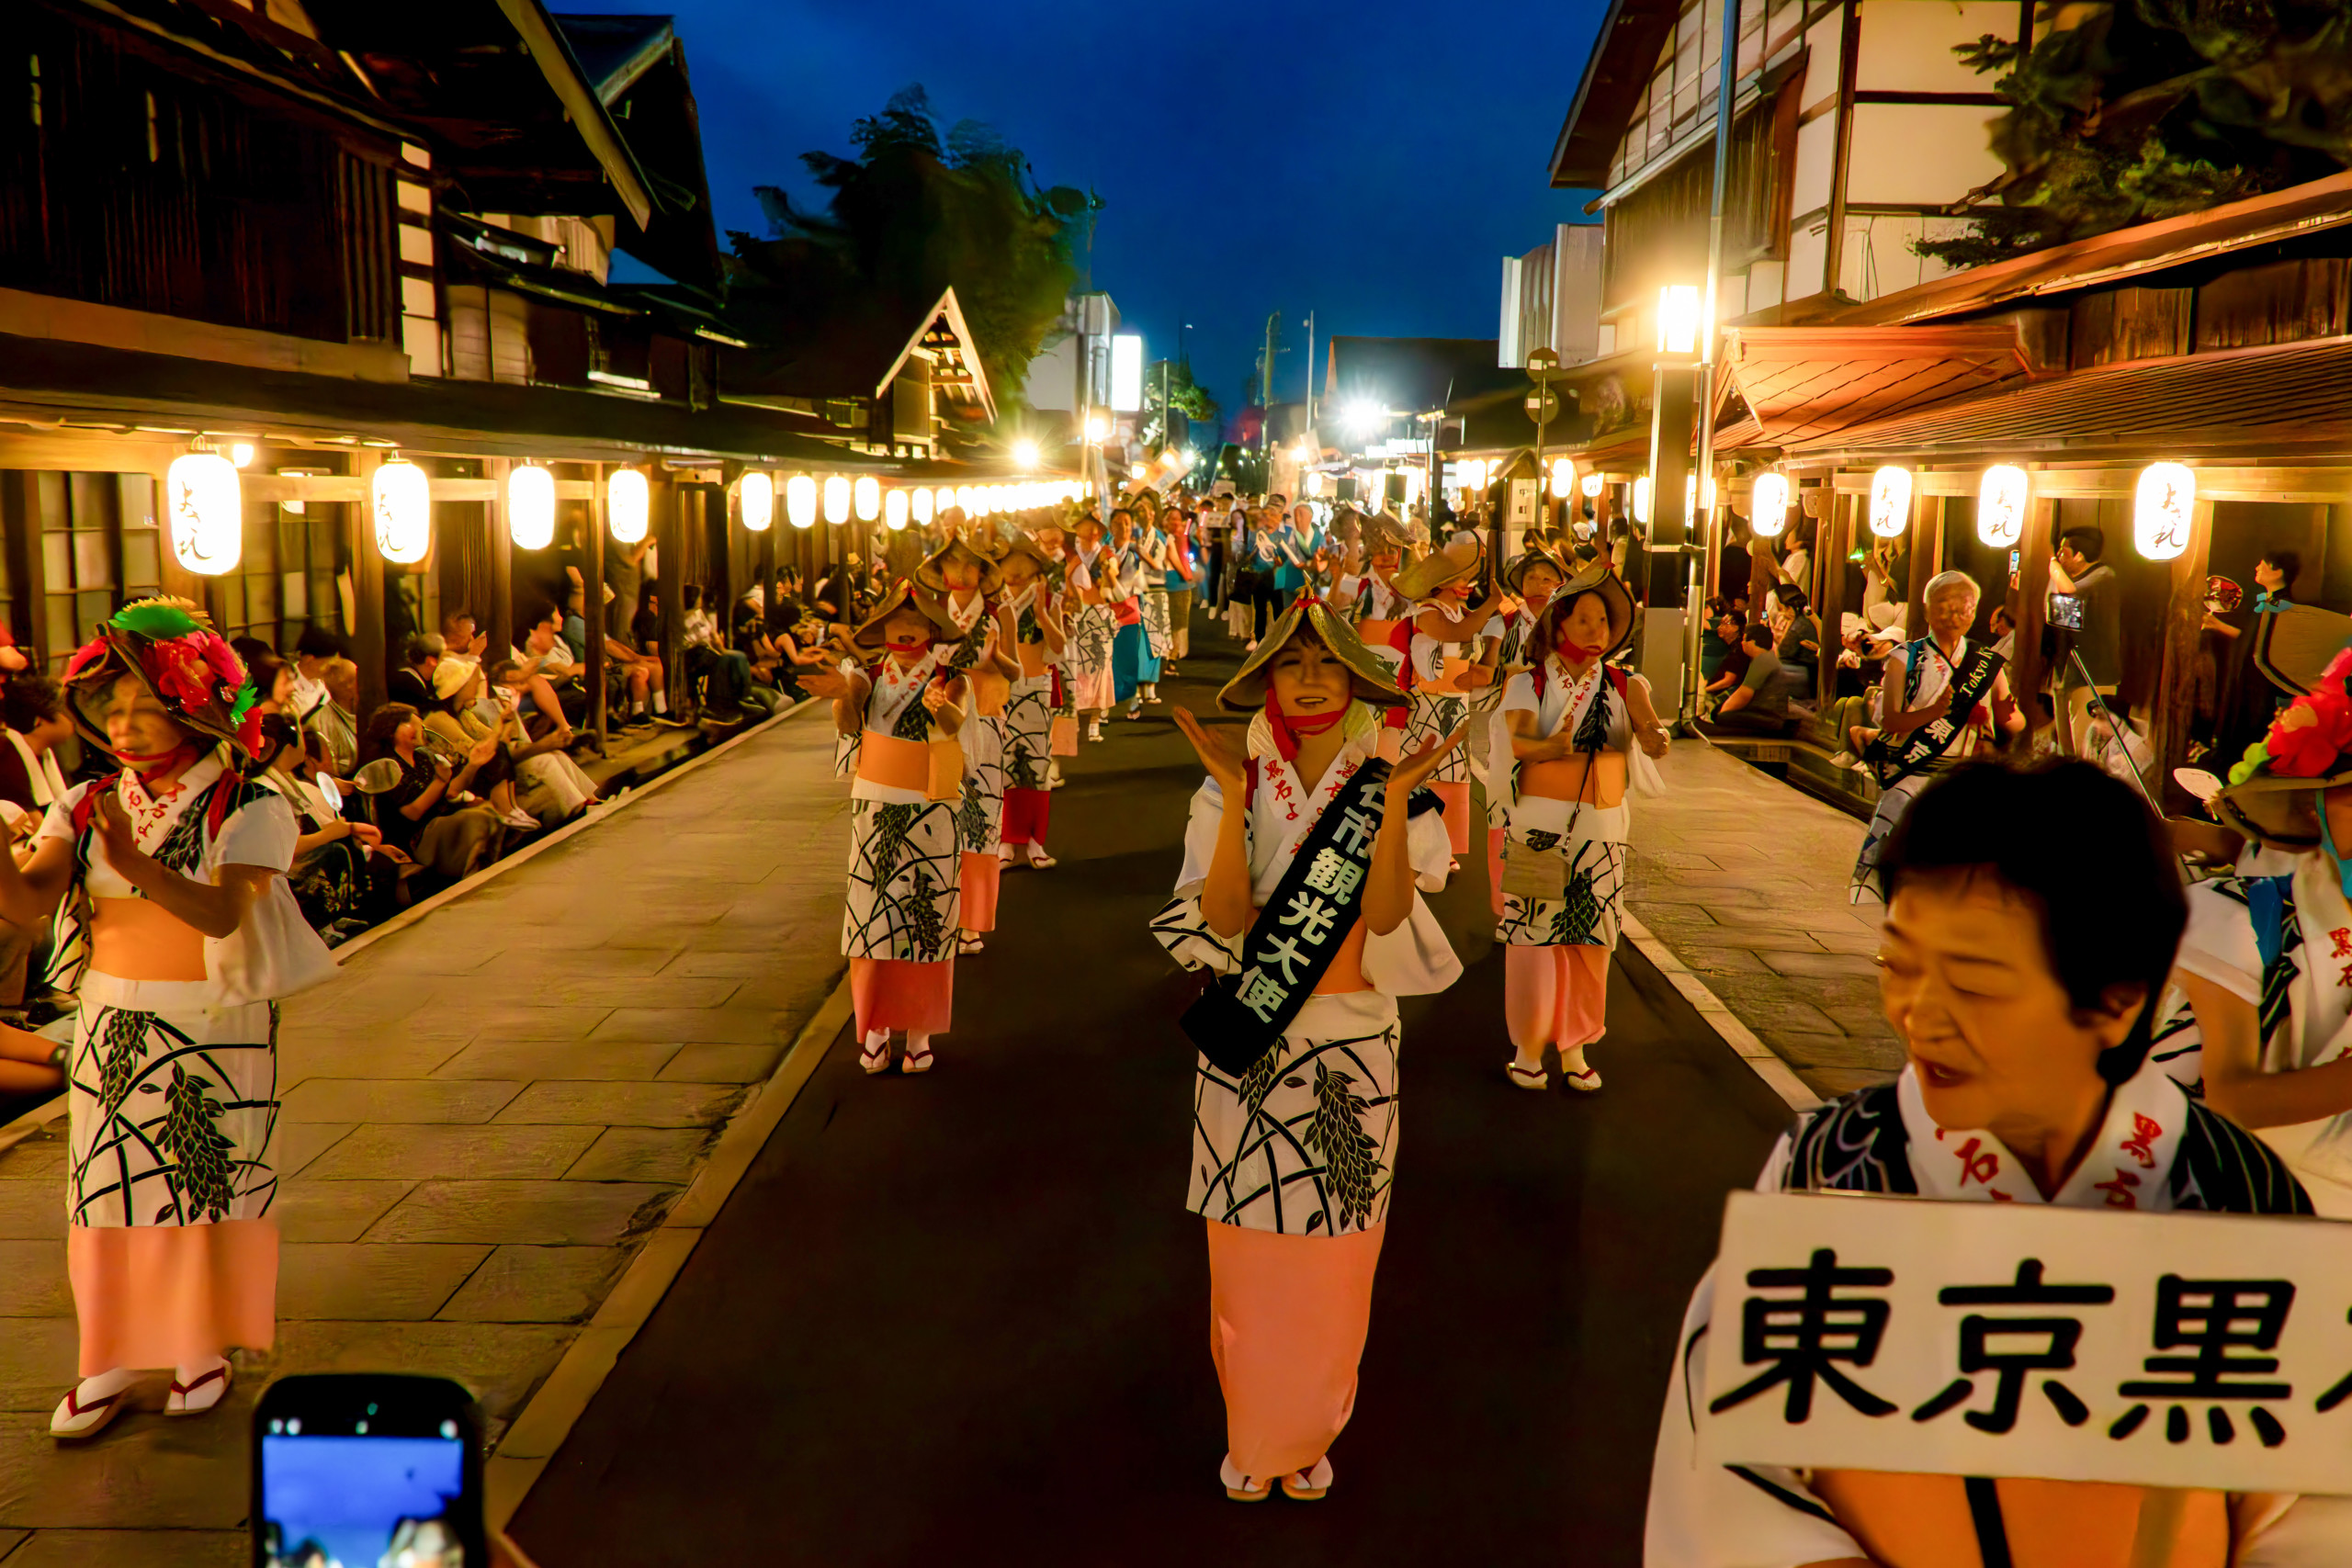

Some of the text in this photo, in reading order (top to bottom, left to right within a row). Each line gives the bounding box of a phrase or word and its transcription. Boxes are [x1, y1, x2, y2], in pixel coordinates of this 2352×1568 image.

[1959, 659, 1989, 698] Tokyo
[1235, 772, 1427, 1024] 石市観光大使
[1709, 1247, 2352, 1449] 東京黒
